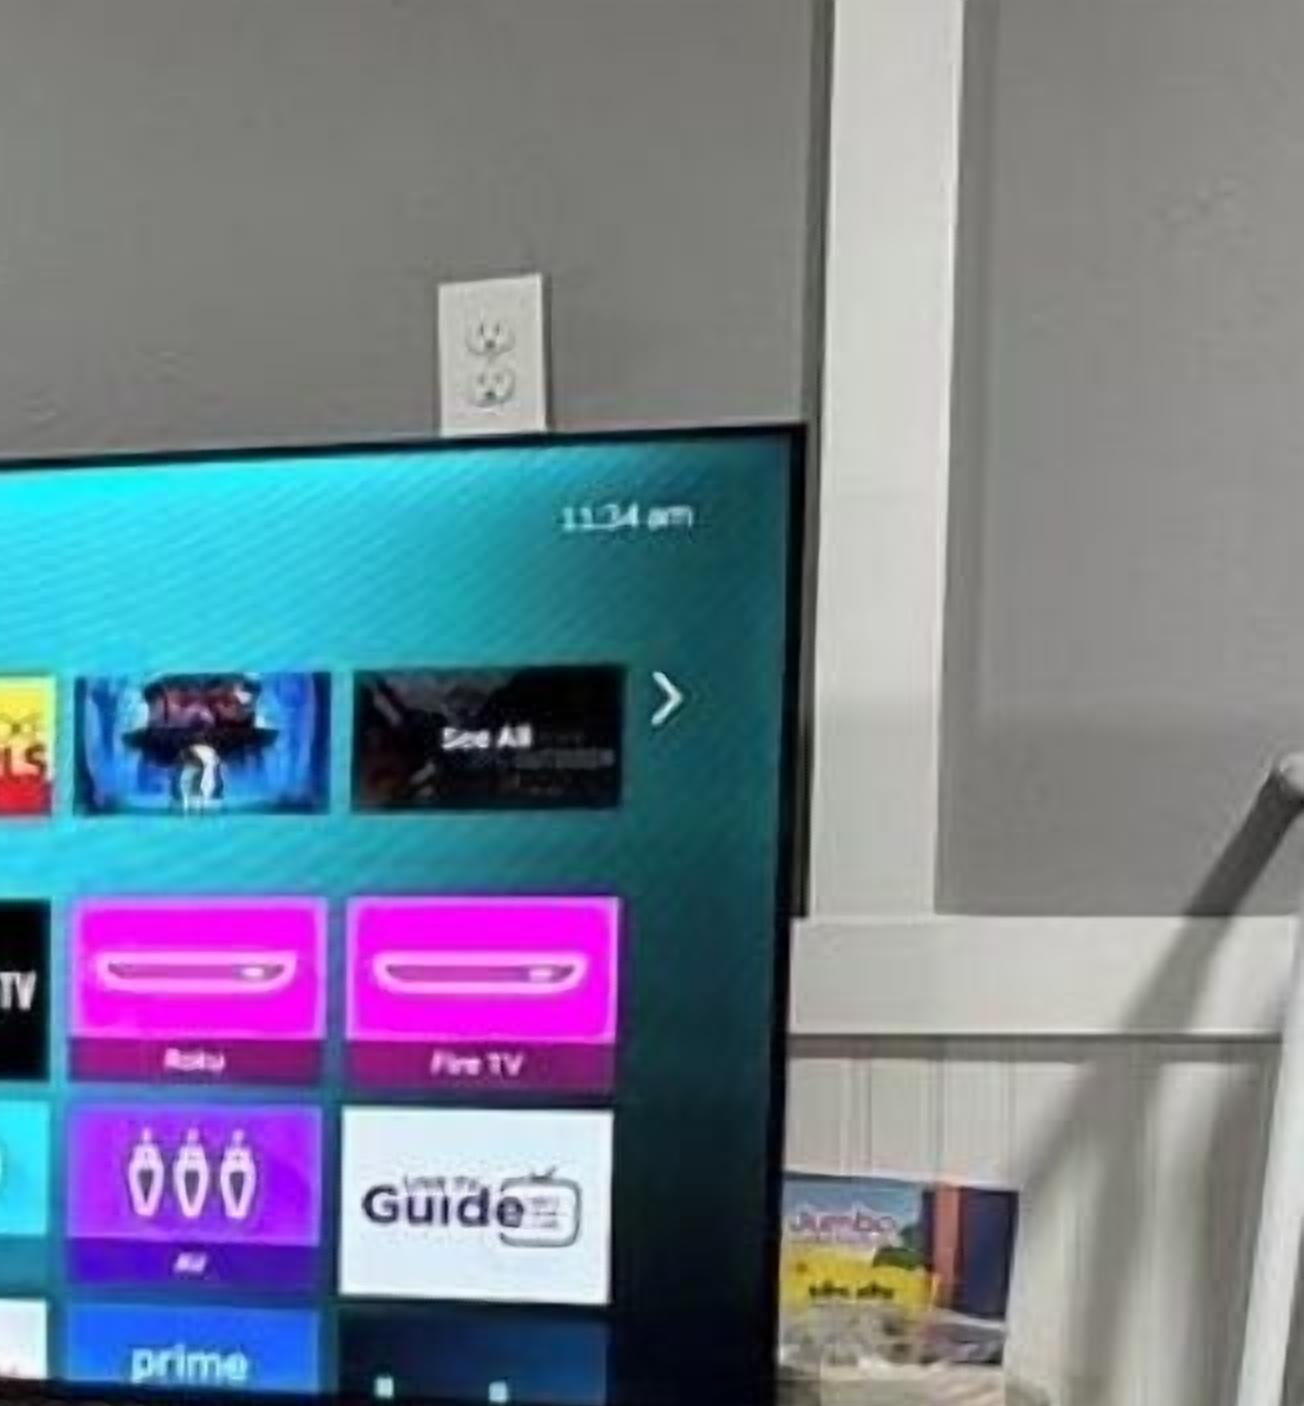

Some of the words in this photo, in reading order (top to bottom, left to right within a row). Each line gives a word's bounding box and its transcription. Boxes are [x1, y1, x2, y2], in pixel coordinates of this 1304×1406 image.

[489, 1051, 524, 1077] TV
[361, 1184, 525, 1229] Guide
[131, 1343, 249, 1383] prime
